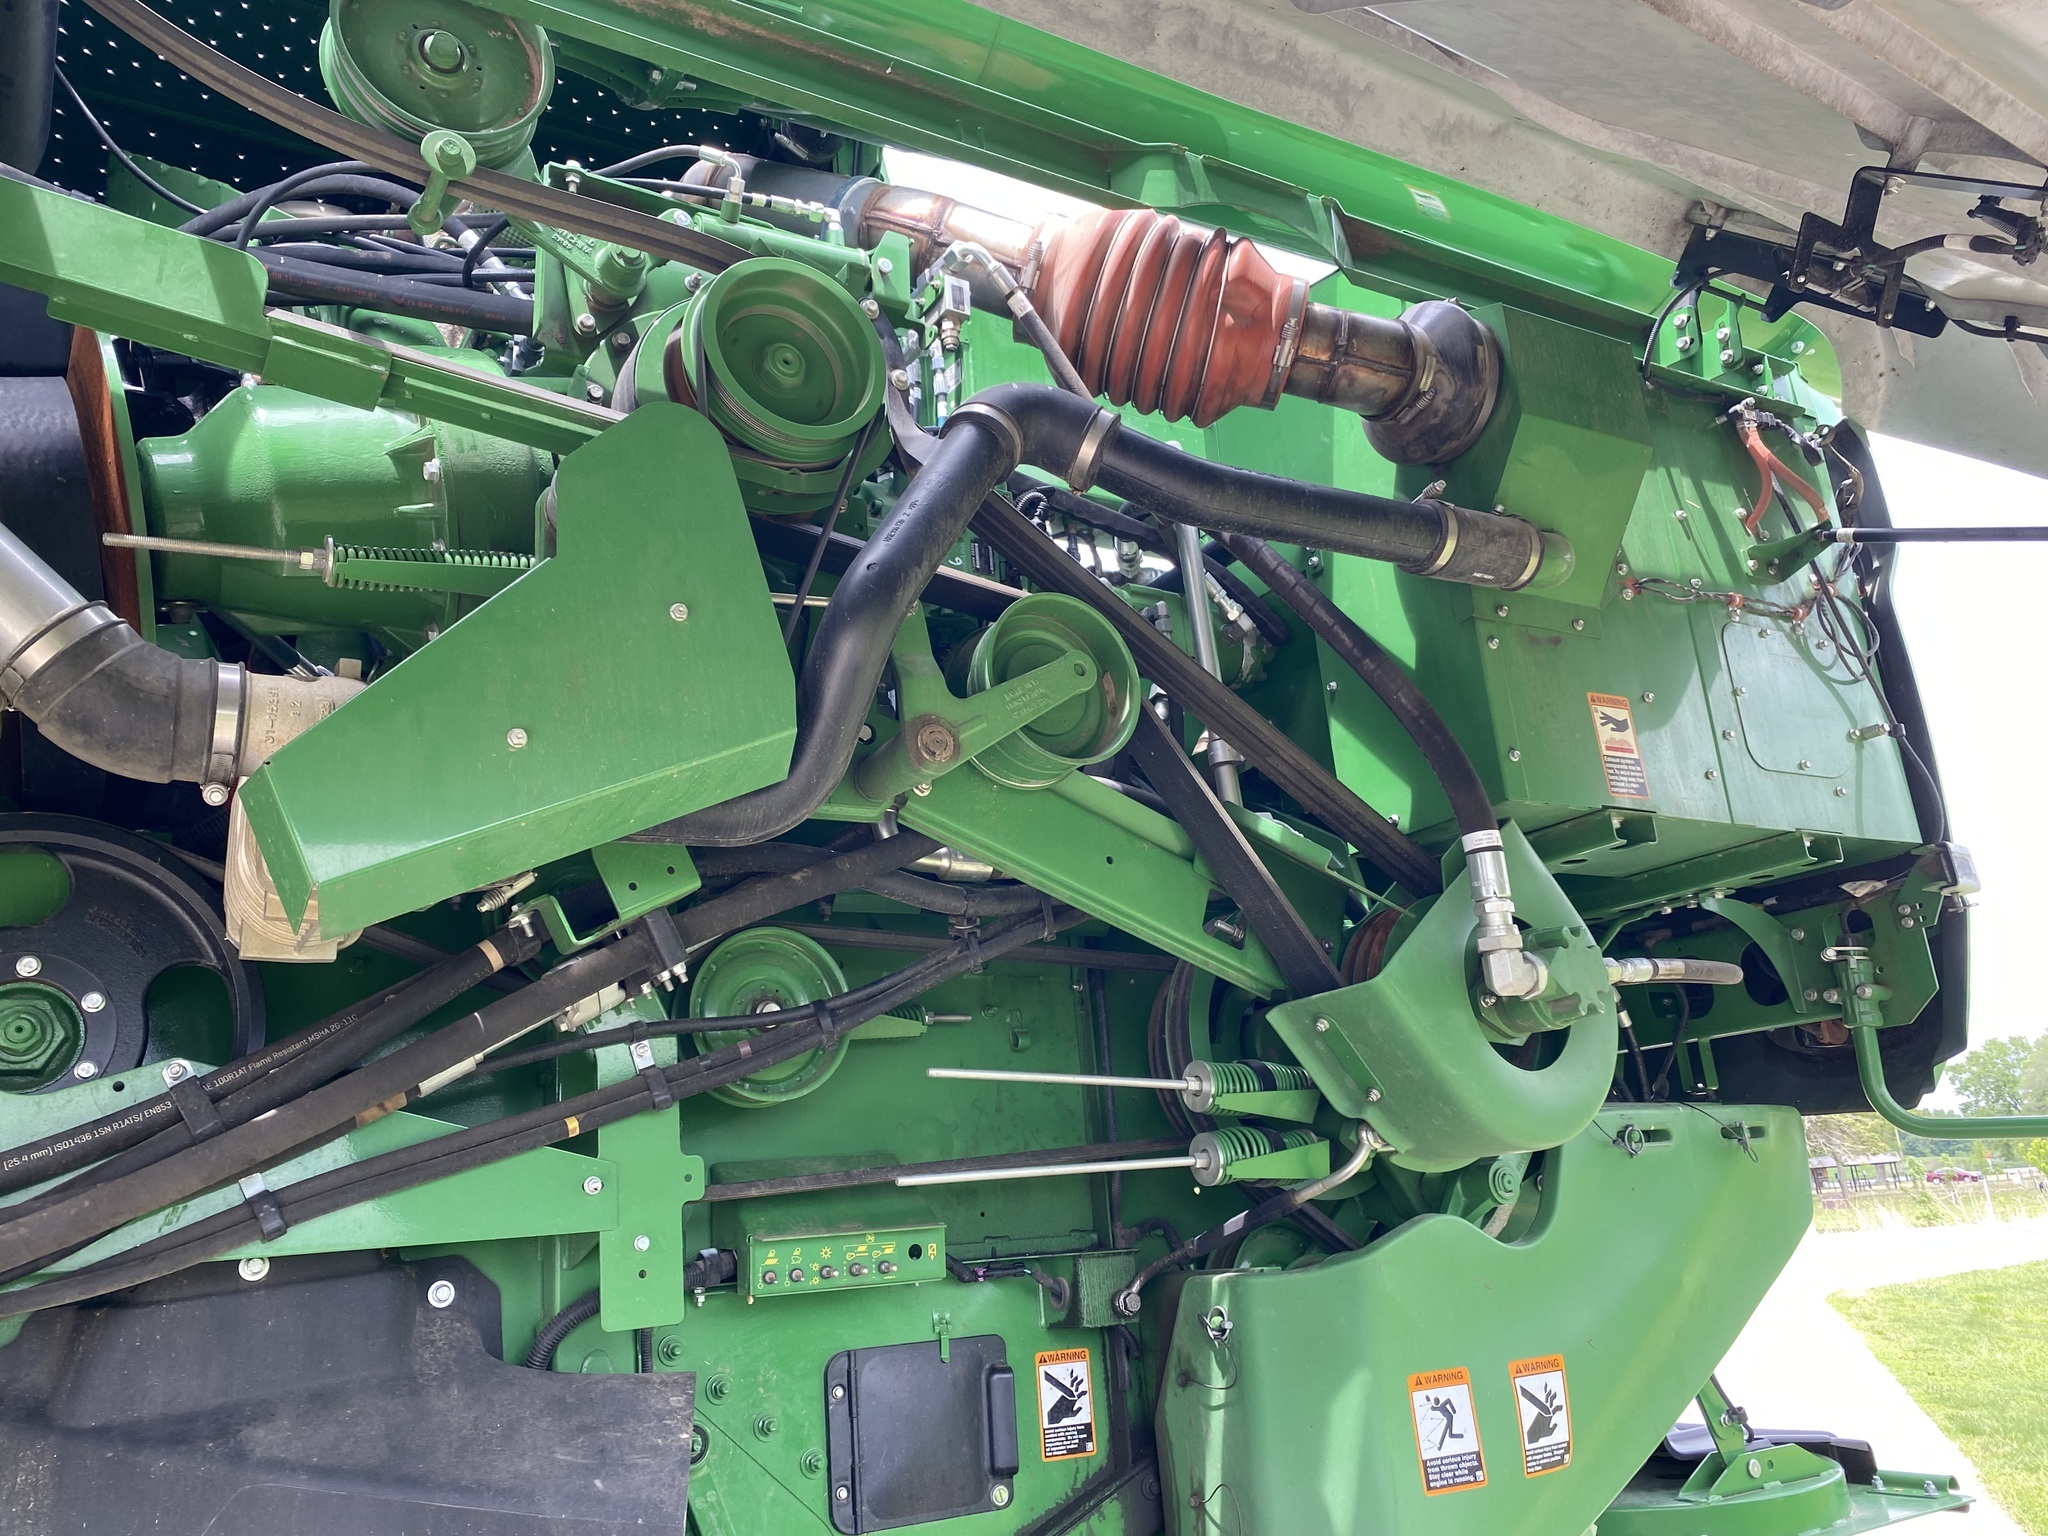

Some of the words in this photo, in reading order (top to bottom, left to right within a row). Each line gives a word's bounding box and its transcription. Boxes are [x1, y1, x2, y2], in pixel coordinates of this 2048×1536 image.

[1596, 695, 1628, 708] WARNING
[214, 1066, 247, 1087] 100R1AT
[248, 1056, 272, 1071] Flame
[272, 1039, 308, 1060] Resistant
[308, 1028, 331, 1043] MSHA
[54, 1132, 92, 1152] ISO1436
[94, 1125, 112, 1138] 1SN
[145, 1101, 173, 1118] EN853
[1047, 1350, 1087, 1363] WARNING
[1522, 1358, 1560, 1373] WARNING
[1424, 1370, 1464, 1384] WARNING
[1427, 1459, 1442, 1467] Avoid
[1442, 1456, 1461, 1465] serious
[1461, 1453, 1477, 1462] injury
[1440, 1464, 1459, 1472] thrown
[1459, 1461, 1480, 1469] objects.
[1428, 1473, 1441, 1481] Stay
[1430, 1479, 1448, 1488] engine
[1454, 1475, 1475, 1483] running.
